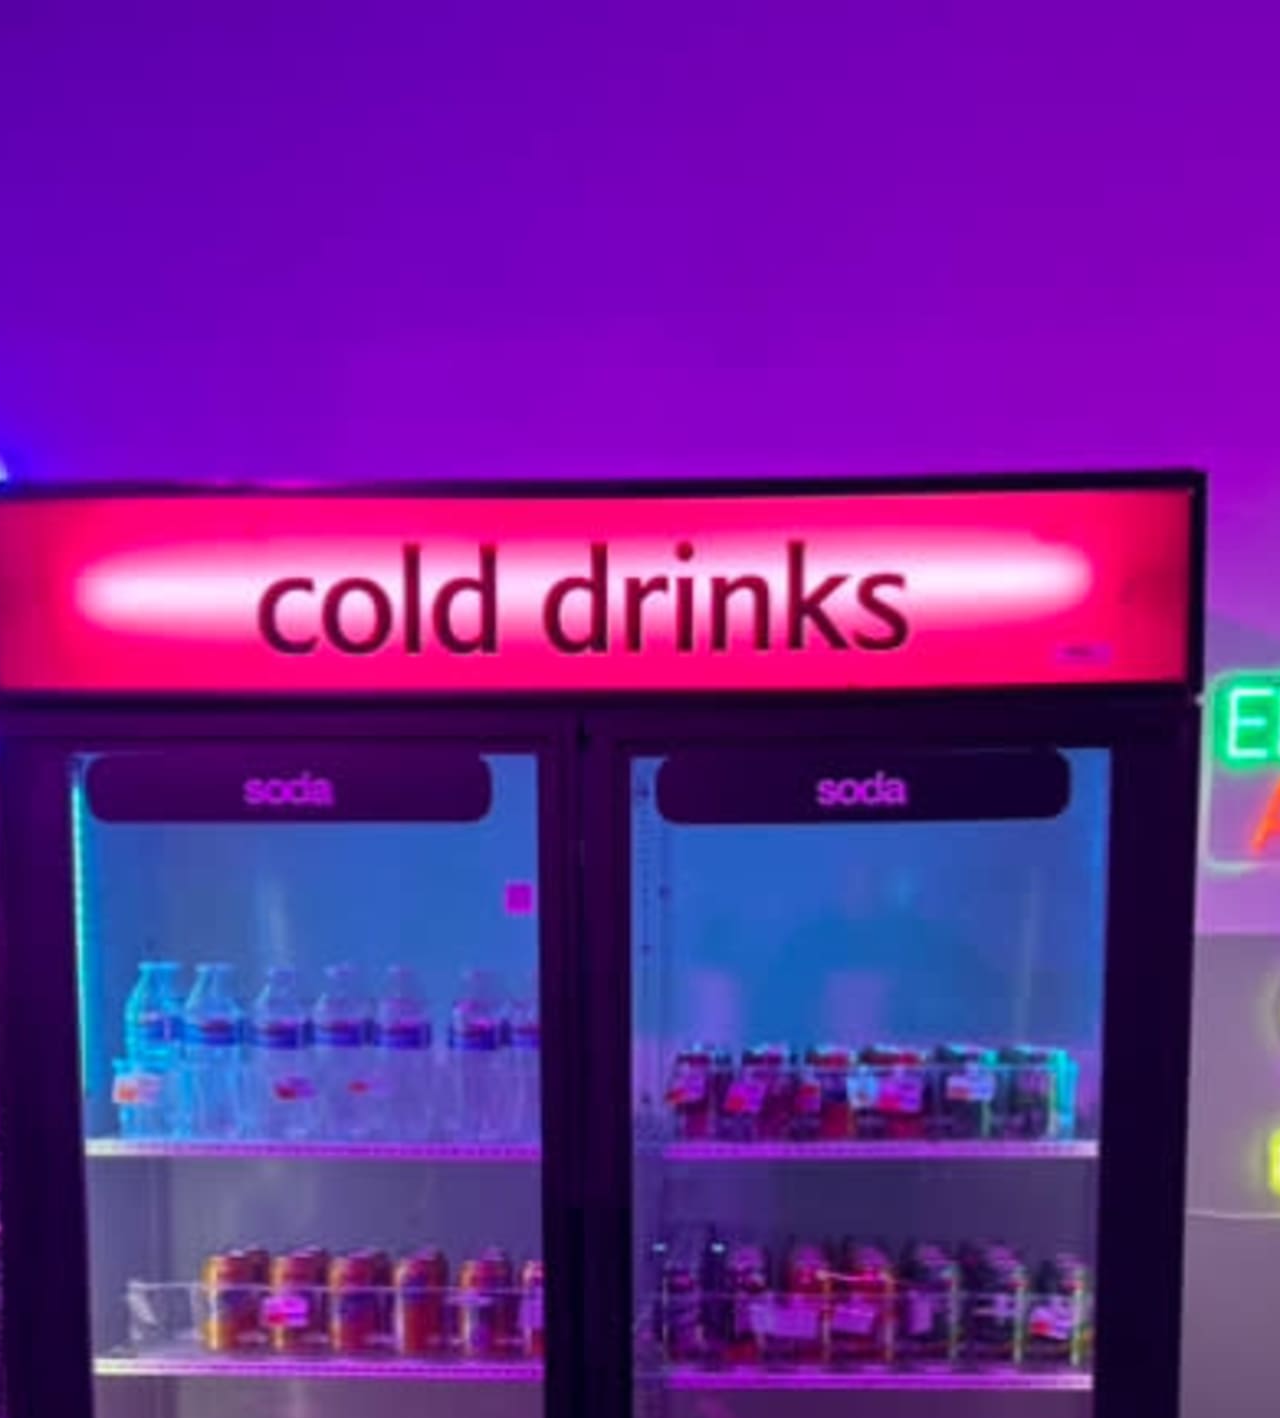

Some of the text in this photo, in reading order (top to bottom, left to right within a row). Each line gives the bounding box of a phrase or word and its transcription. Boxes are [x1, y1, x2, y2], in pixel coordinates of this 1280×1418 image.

[256, 539, 911, 655] cold drinks
[242, 769, 336, 806] soda
[816, 769, 910, 806] soda
